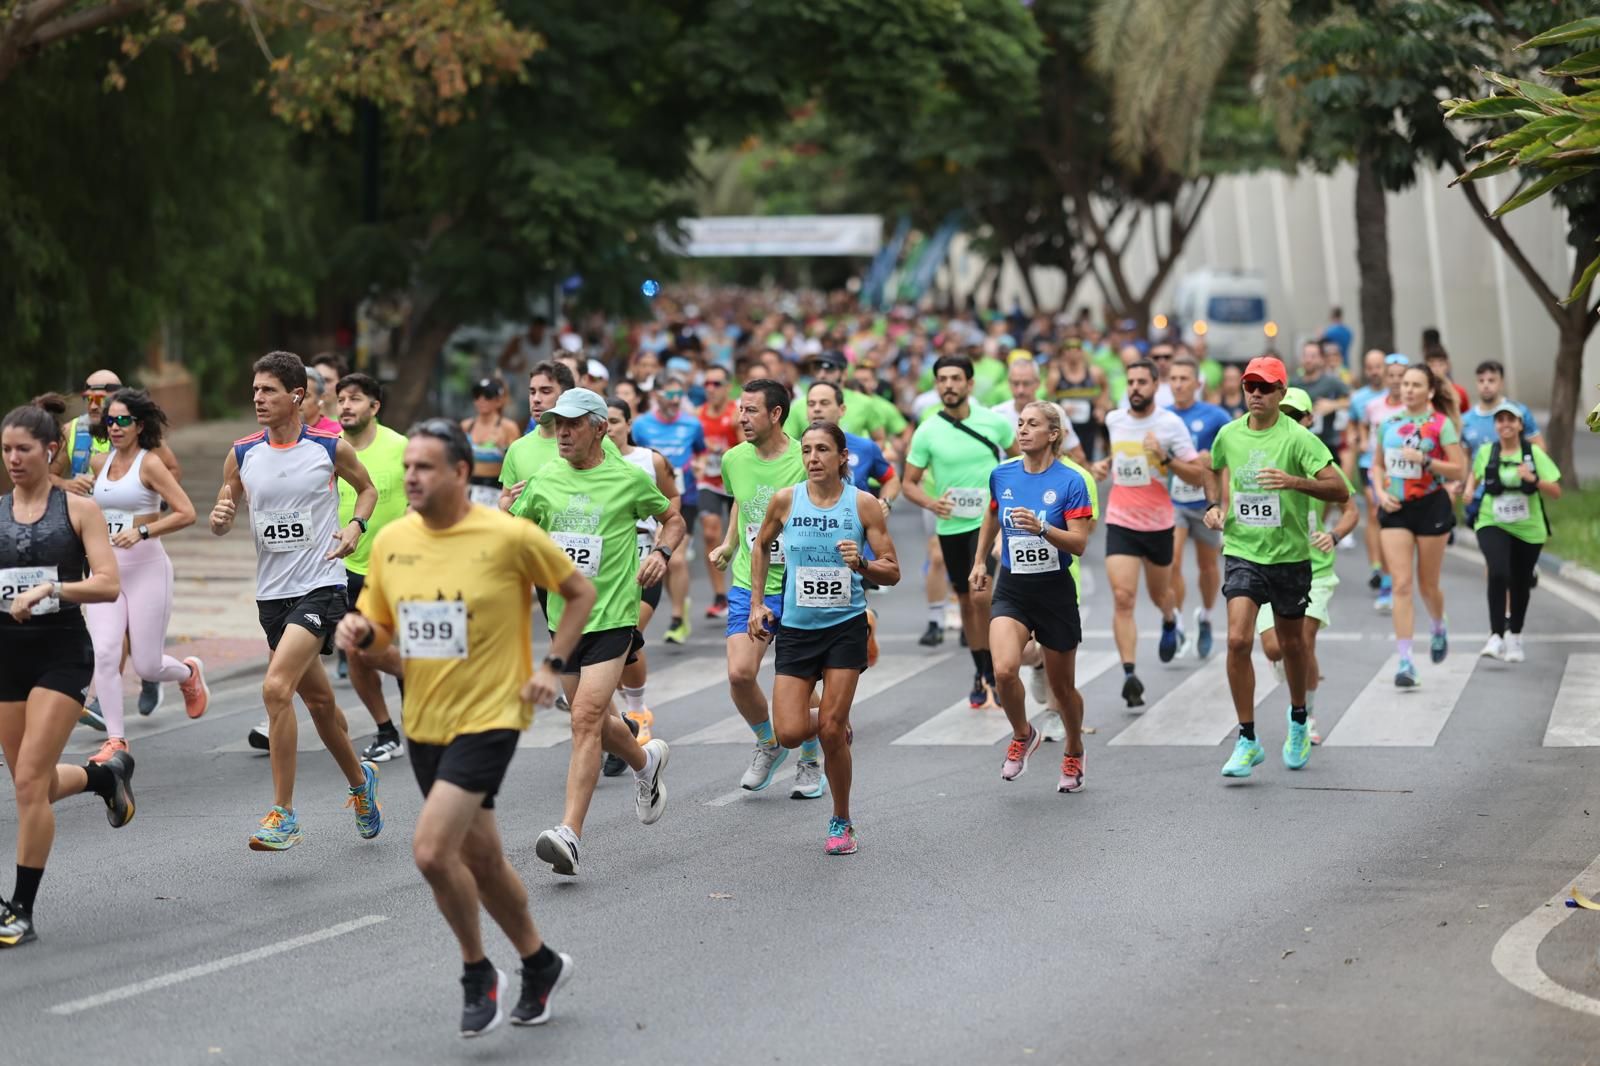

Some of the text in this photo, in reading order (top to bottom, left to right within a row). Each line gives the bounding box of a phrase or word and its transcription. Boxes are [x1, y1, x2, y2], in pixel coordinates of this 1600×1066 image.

[1240, 504, 1272, 517] 618
[792, 515, 840, 531] nerja
[263, 523, 304, 540] 459
[559, 547, 591, 565] 32
[1015, 548, 1050, 563] 268
[2, 584, 42, 601] 25
[803, 580, 842, 596] 582
[408, 621, 452, 640] 599
